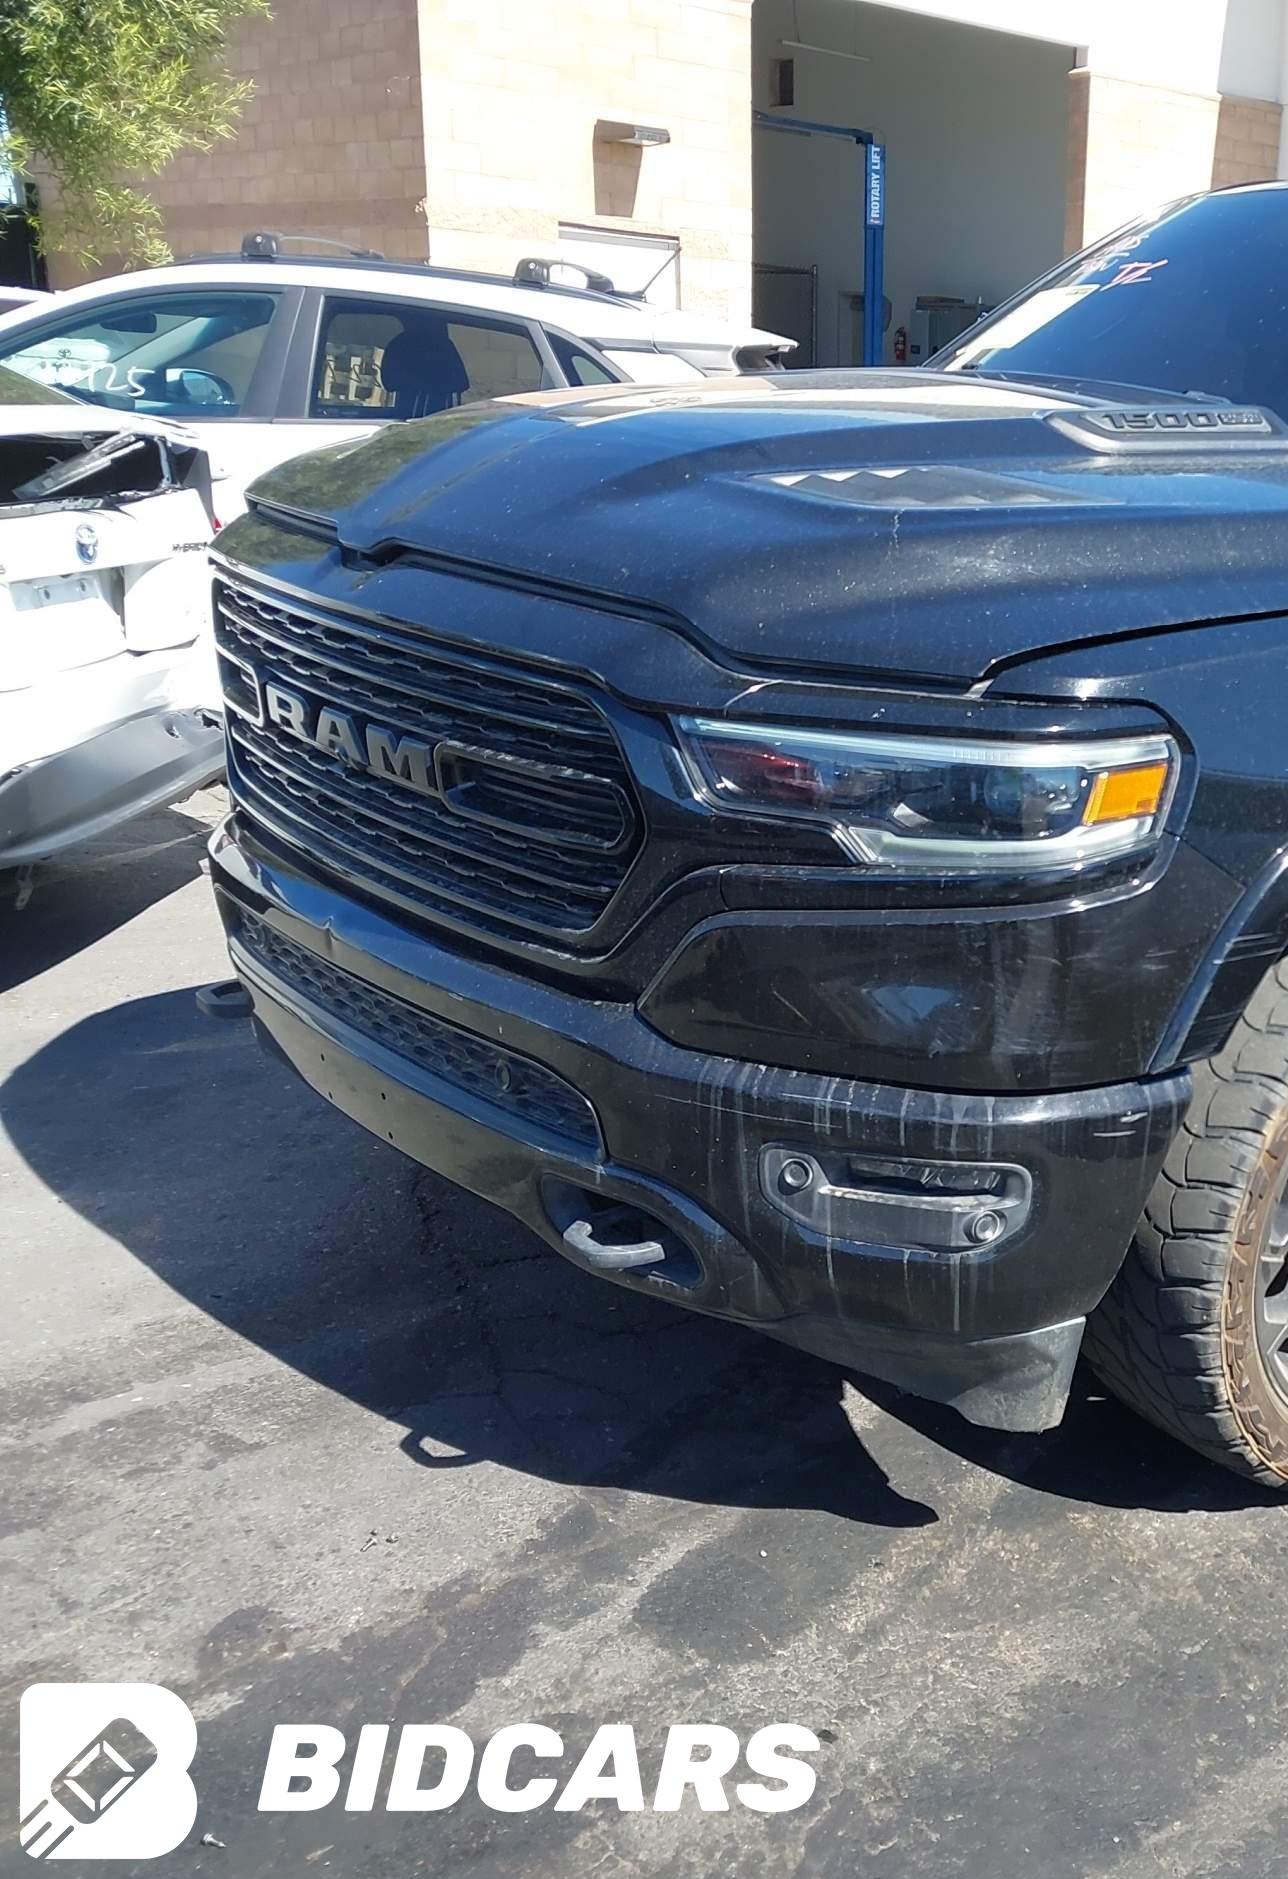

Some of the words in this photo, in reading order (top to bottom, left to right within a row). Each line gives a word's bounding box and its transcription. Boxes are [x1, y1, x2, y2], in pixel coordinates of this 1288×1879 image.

[871, 145, 881, 169] LIFT
[871, 172, 881, 218] ROTARY
[1103, 413, 1218, 428] 1500
[266, 681, 436, 790] RAM
